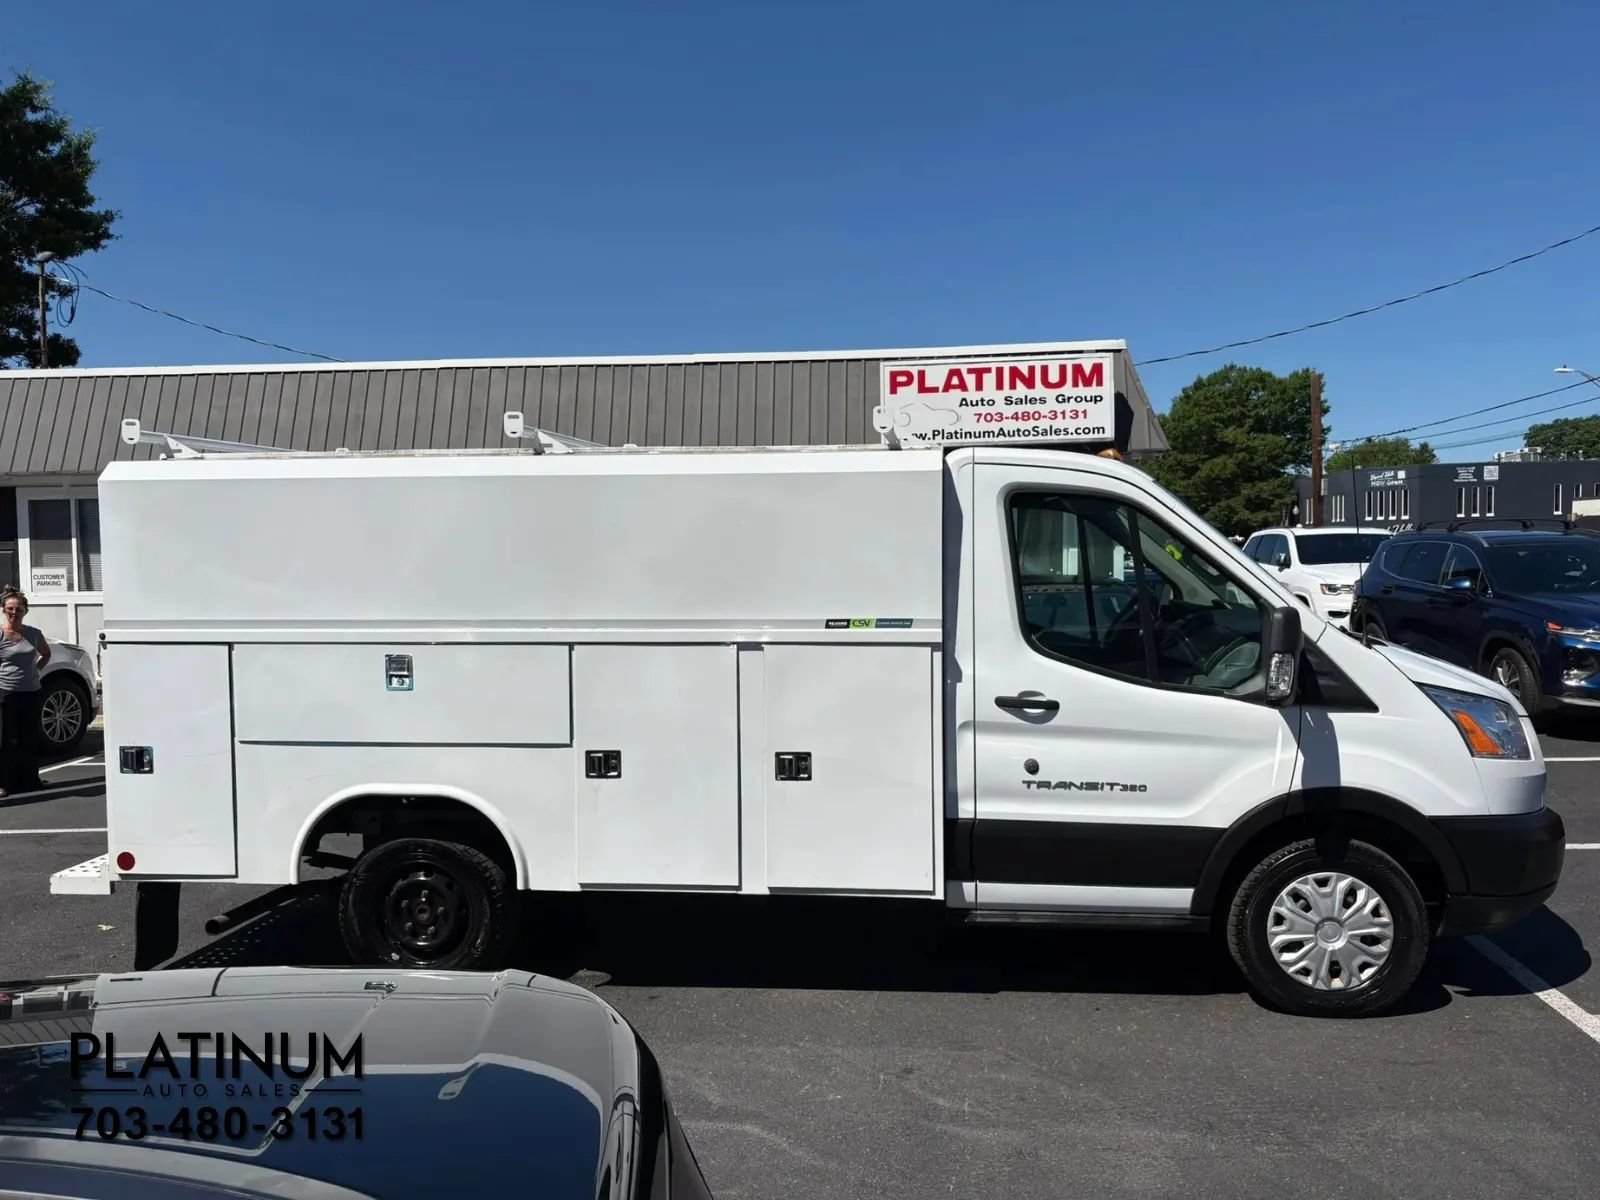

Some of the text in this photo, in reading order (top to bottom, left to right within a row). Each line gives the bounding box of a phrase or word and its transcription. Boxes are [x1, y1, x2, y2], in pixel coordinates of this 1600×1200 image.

[889, 362, 1104, 395] PLATINUM
[958, 393, 1104, 408] Auto Sales Group
[973, 409, 1089, 423] 703-480-3131
[852, 619, 871, 627] CSV
